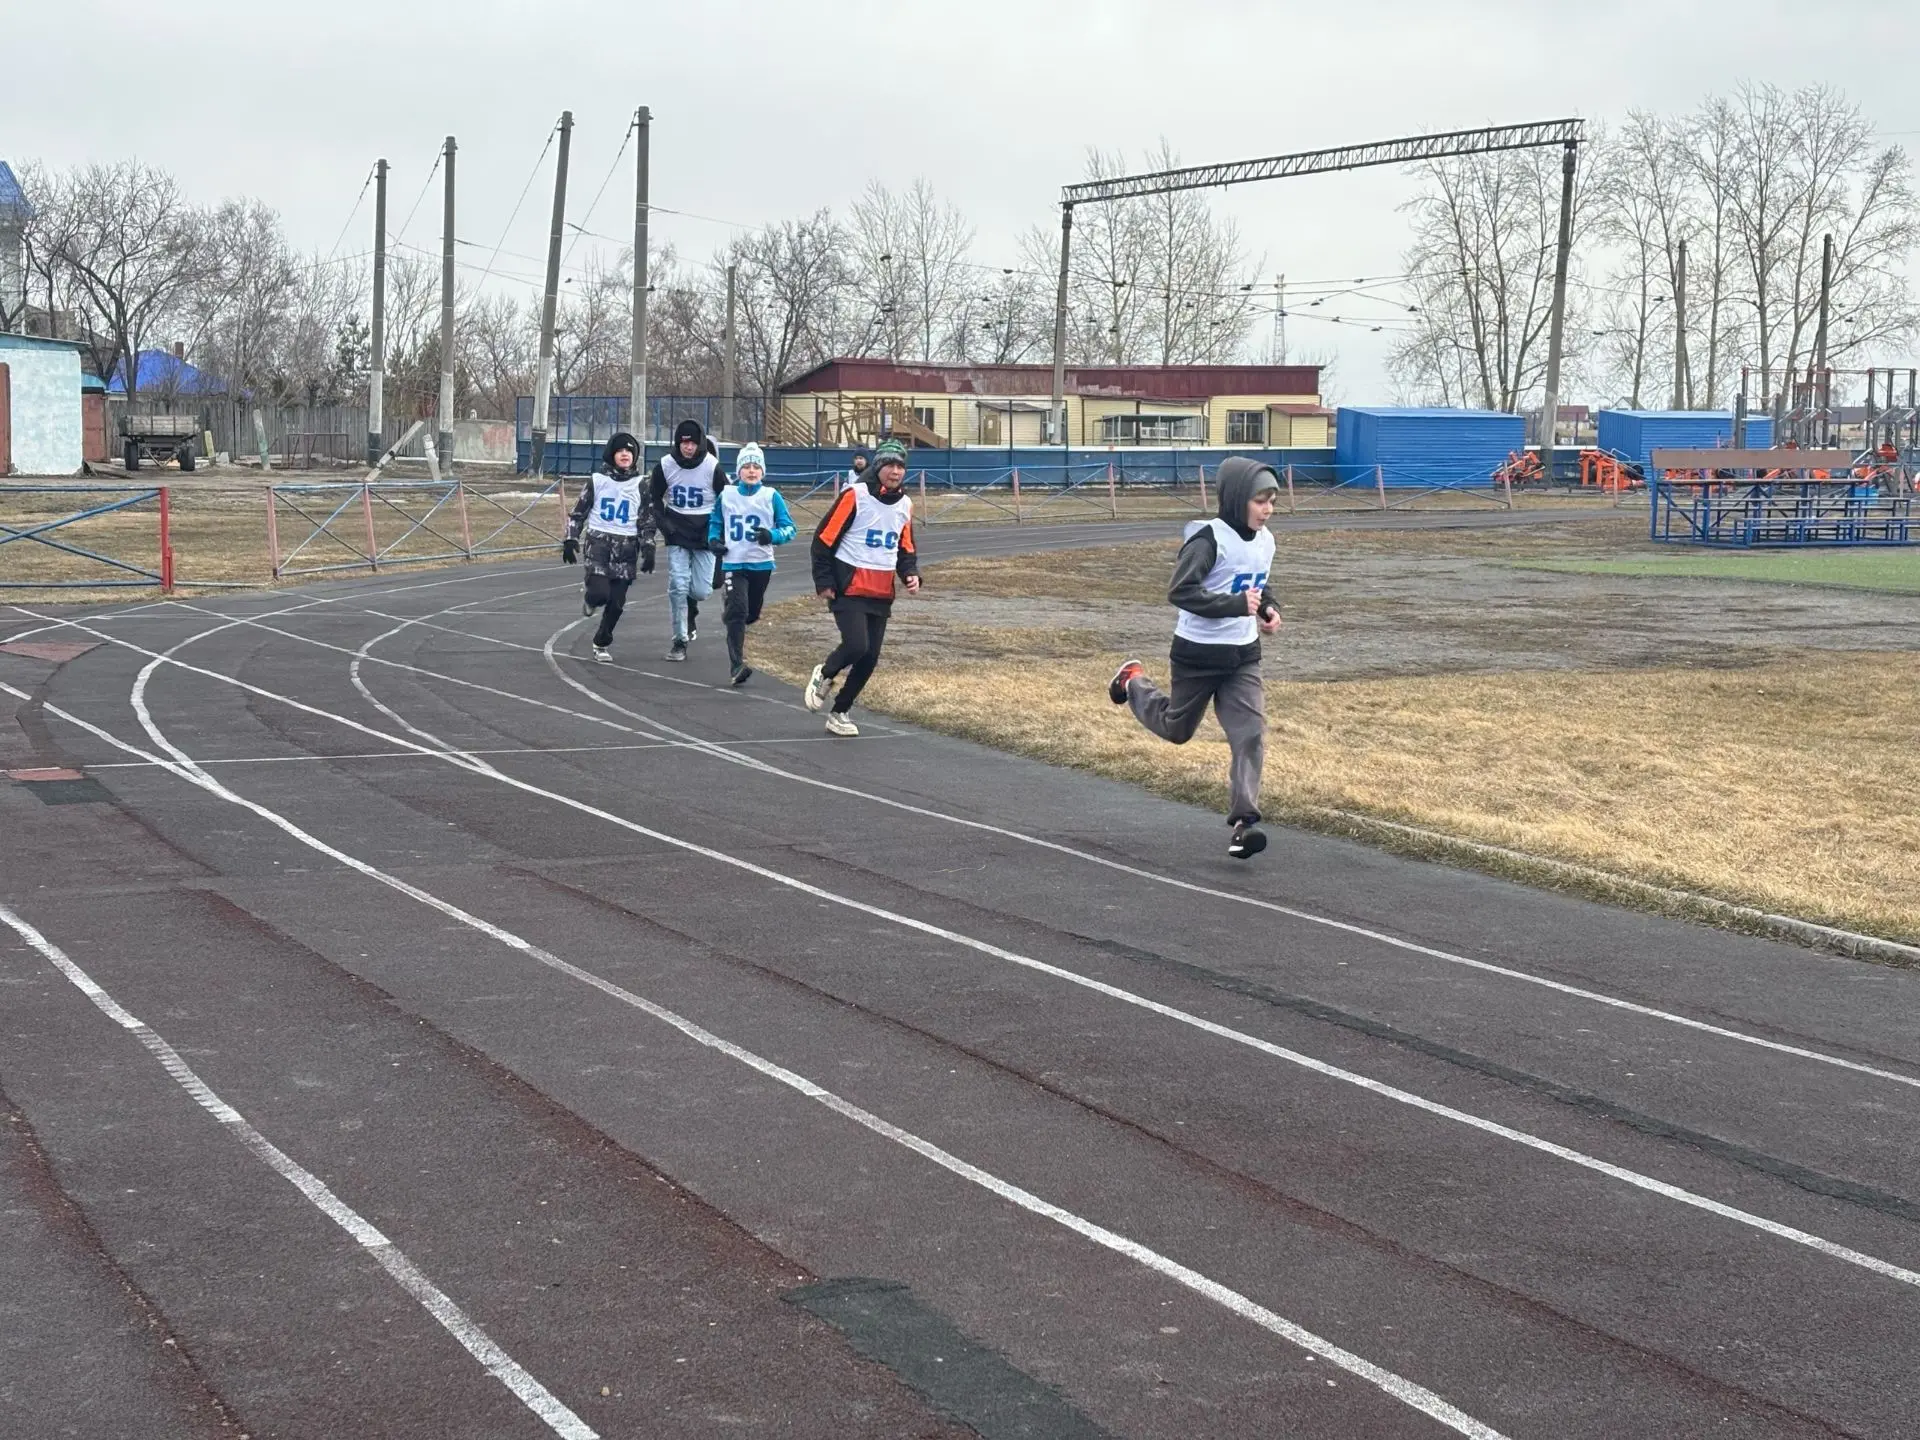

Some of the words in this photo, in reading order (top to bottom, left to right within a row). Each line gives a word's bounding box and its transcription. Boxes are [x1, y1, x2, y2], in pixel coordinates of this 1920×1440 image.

[599, 497, 630, 524] 54
[672, 485, 704, 509] 65
[729, 514, 761, 543] 53
